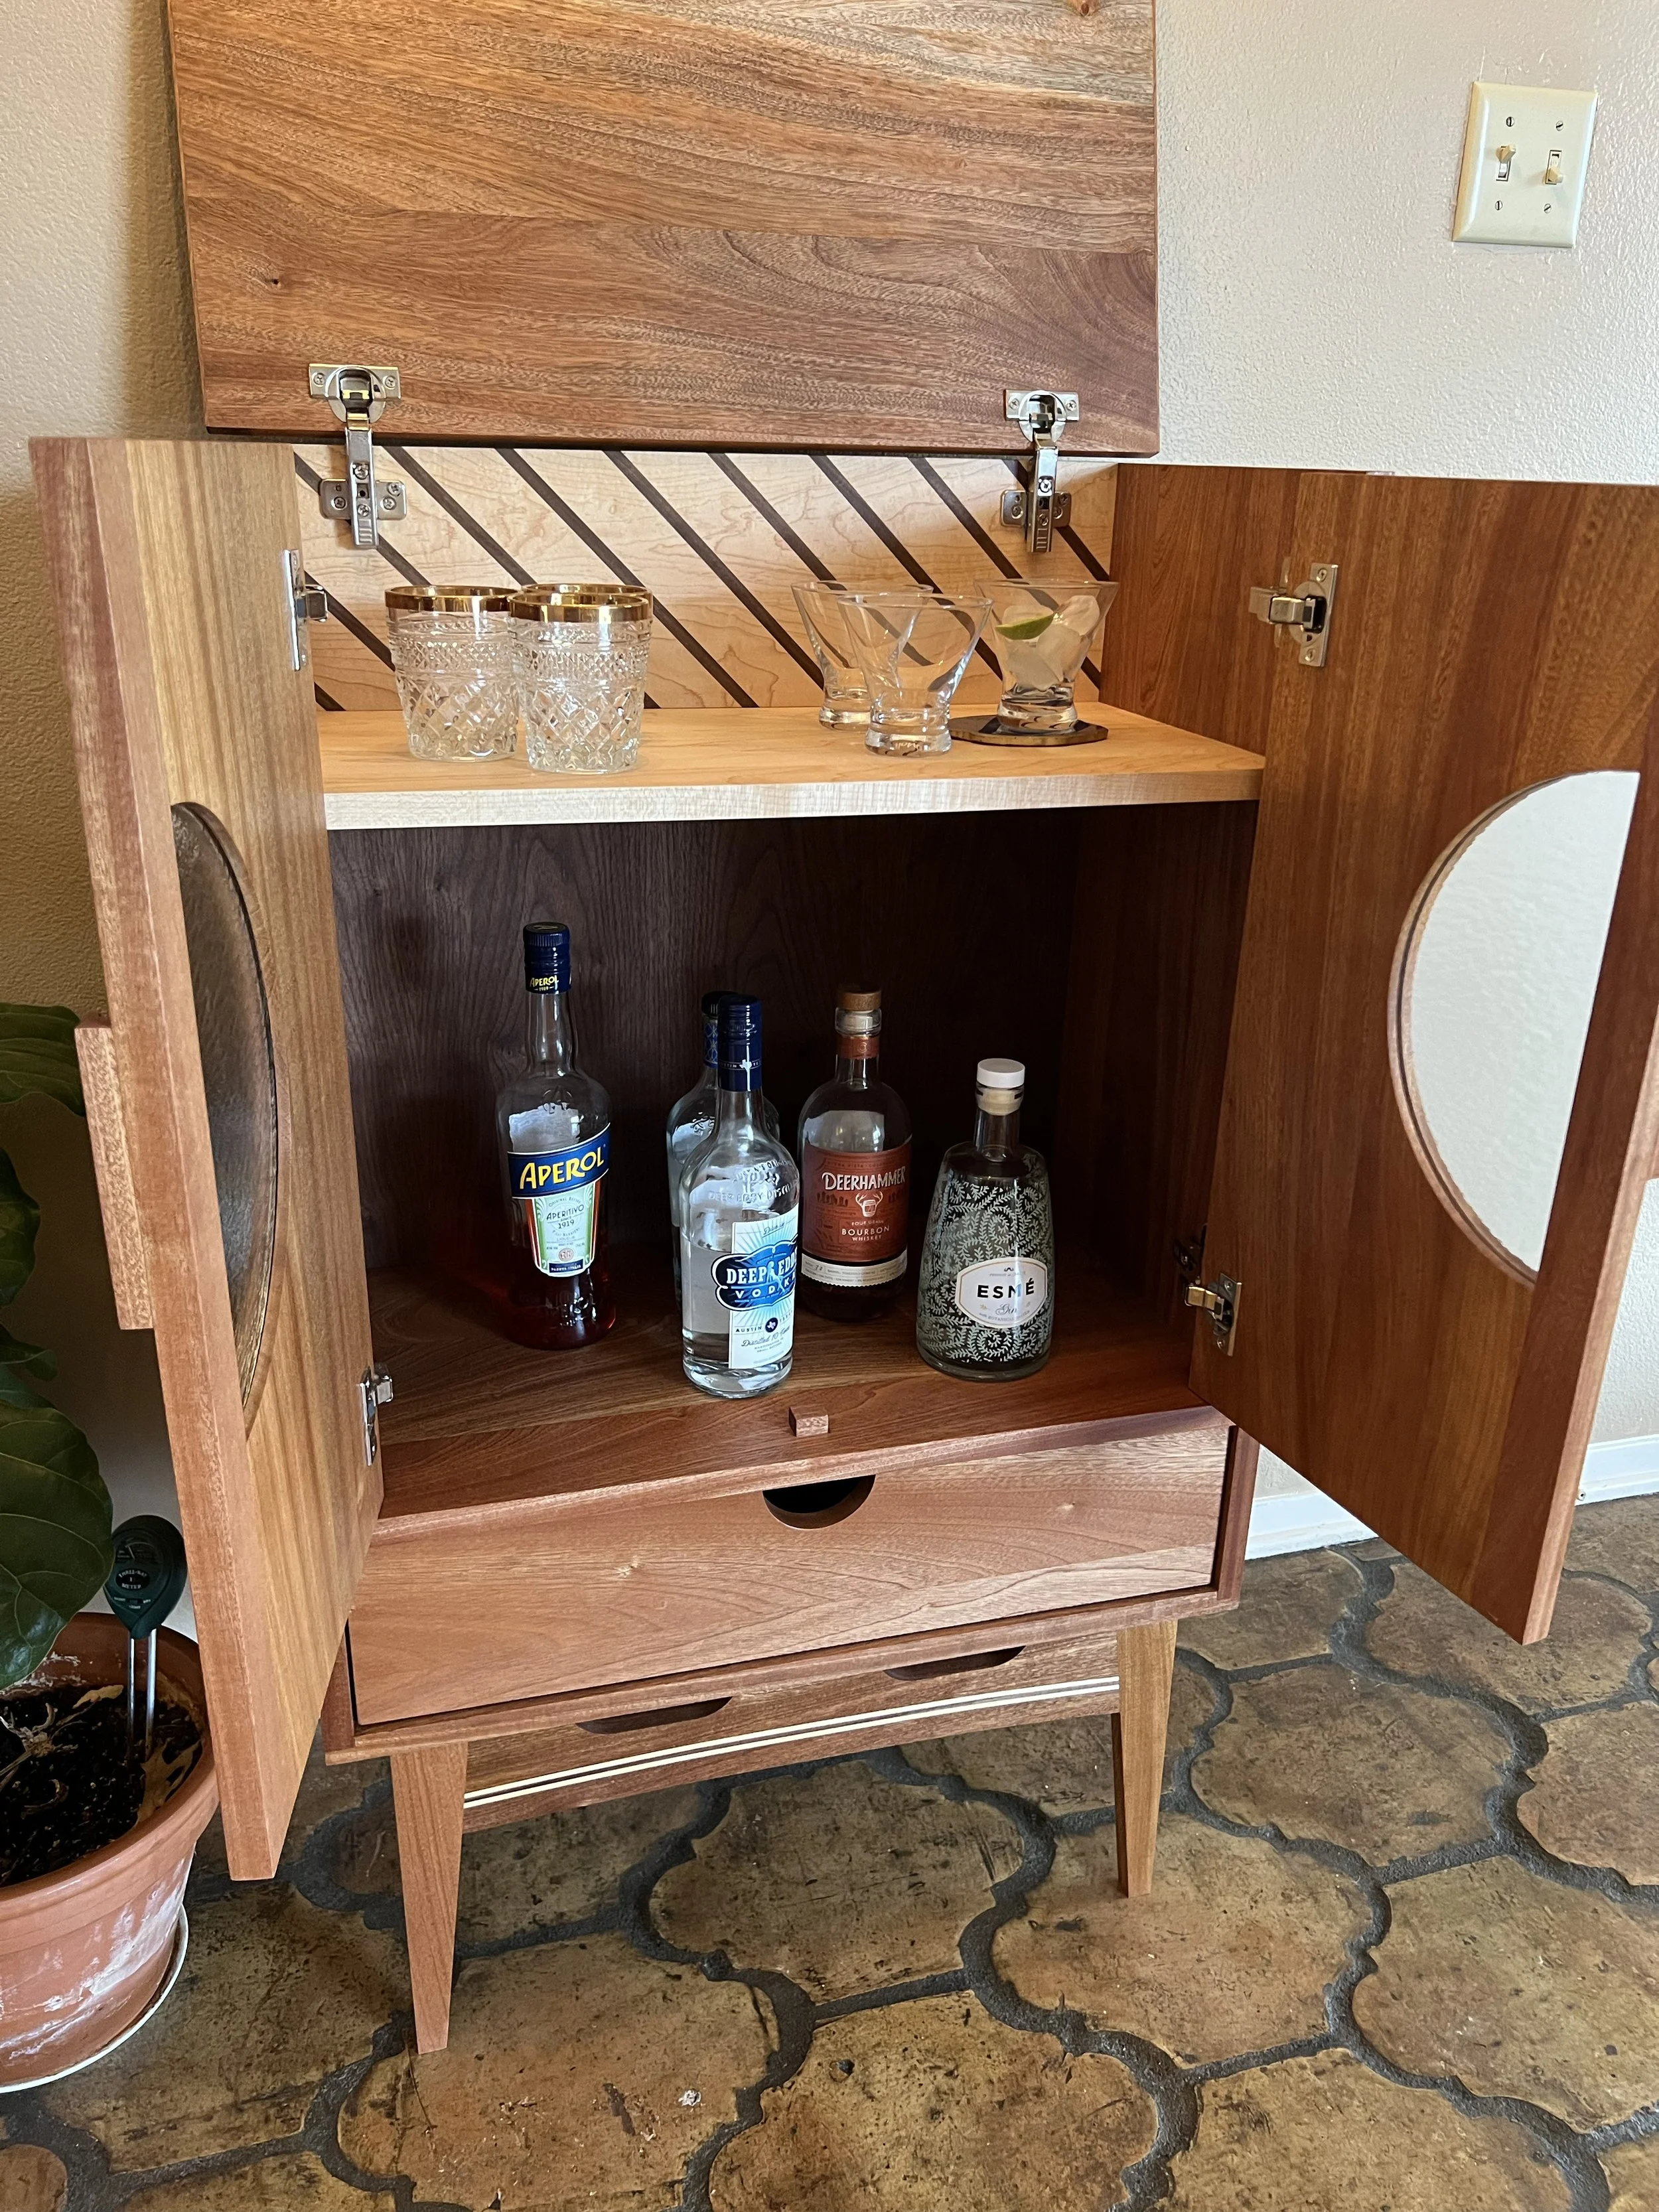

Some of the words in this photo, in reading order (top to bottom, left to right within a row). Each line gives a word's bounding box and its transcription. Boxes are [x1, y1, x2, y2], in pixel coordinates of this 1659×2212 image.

[530, 976, 559, 987] APEROL
[520, 1147, 604, 1189] APEROL
[822, 1166, 906, 1191] DEERHAMMER
[546, 1204, 585, 1221] APERITIVO
[558, 1219, 575, 1229] 1919
[841, 1225, 889, 1236] BOURBON
[726, 1266, 767, 1284] DEEP
[778, 1252, 796, 1276] EDD
[977, 1278, 1035, 1299] ESMÉ
[995, 1303, 1017, 1315] Gin
